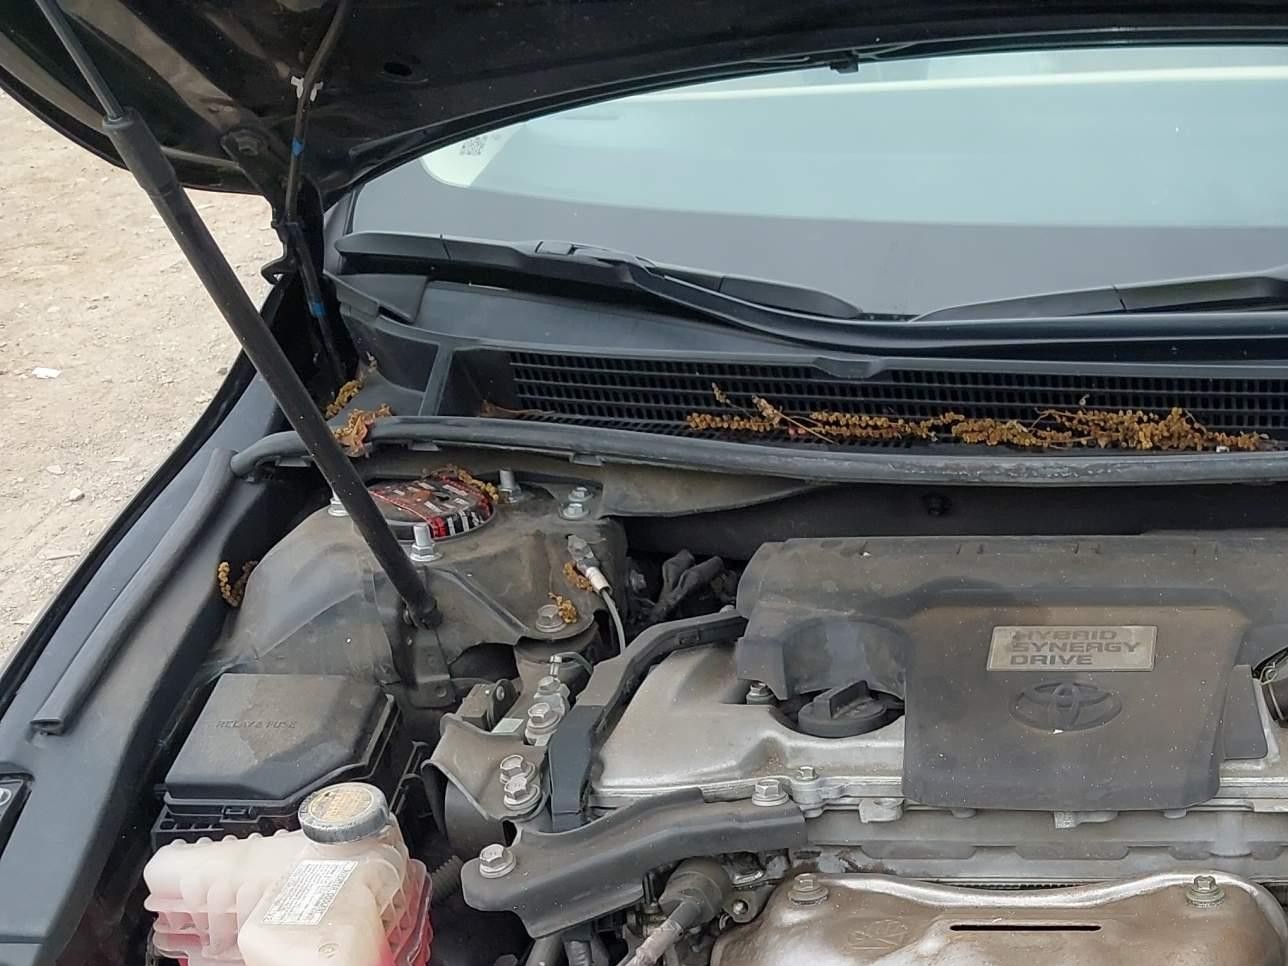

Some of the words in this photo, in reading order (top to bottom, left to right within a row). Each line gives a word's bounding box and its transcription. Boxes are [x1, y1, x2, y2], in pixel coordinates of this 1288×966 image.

[1013, 630, 1117, 640] HYBRID
[1012, 642, 1141, 652] SYNERGY
[1010, 655, 1093, 665] DRIVE
